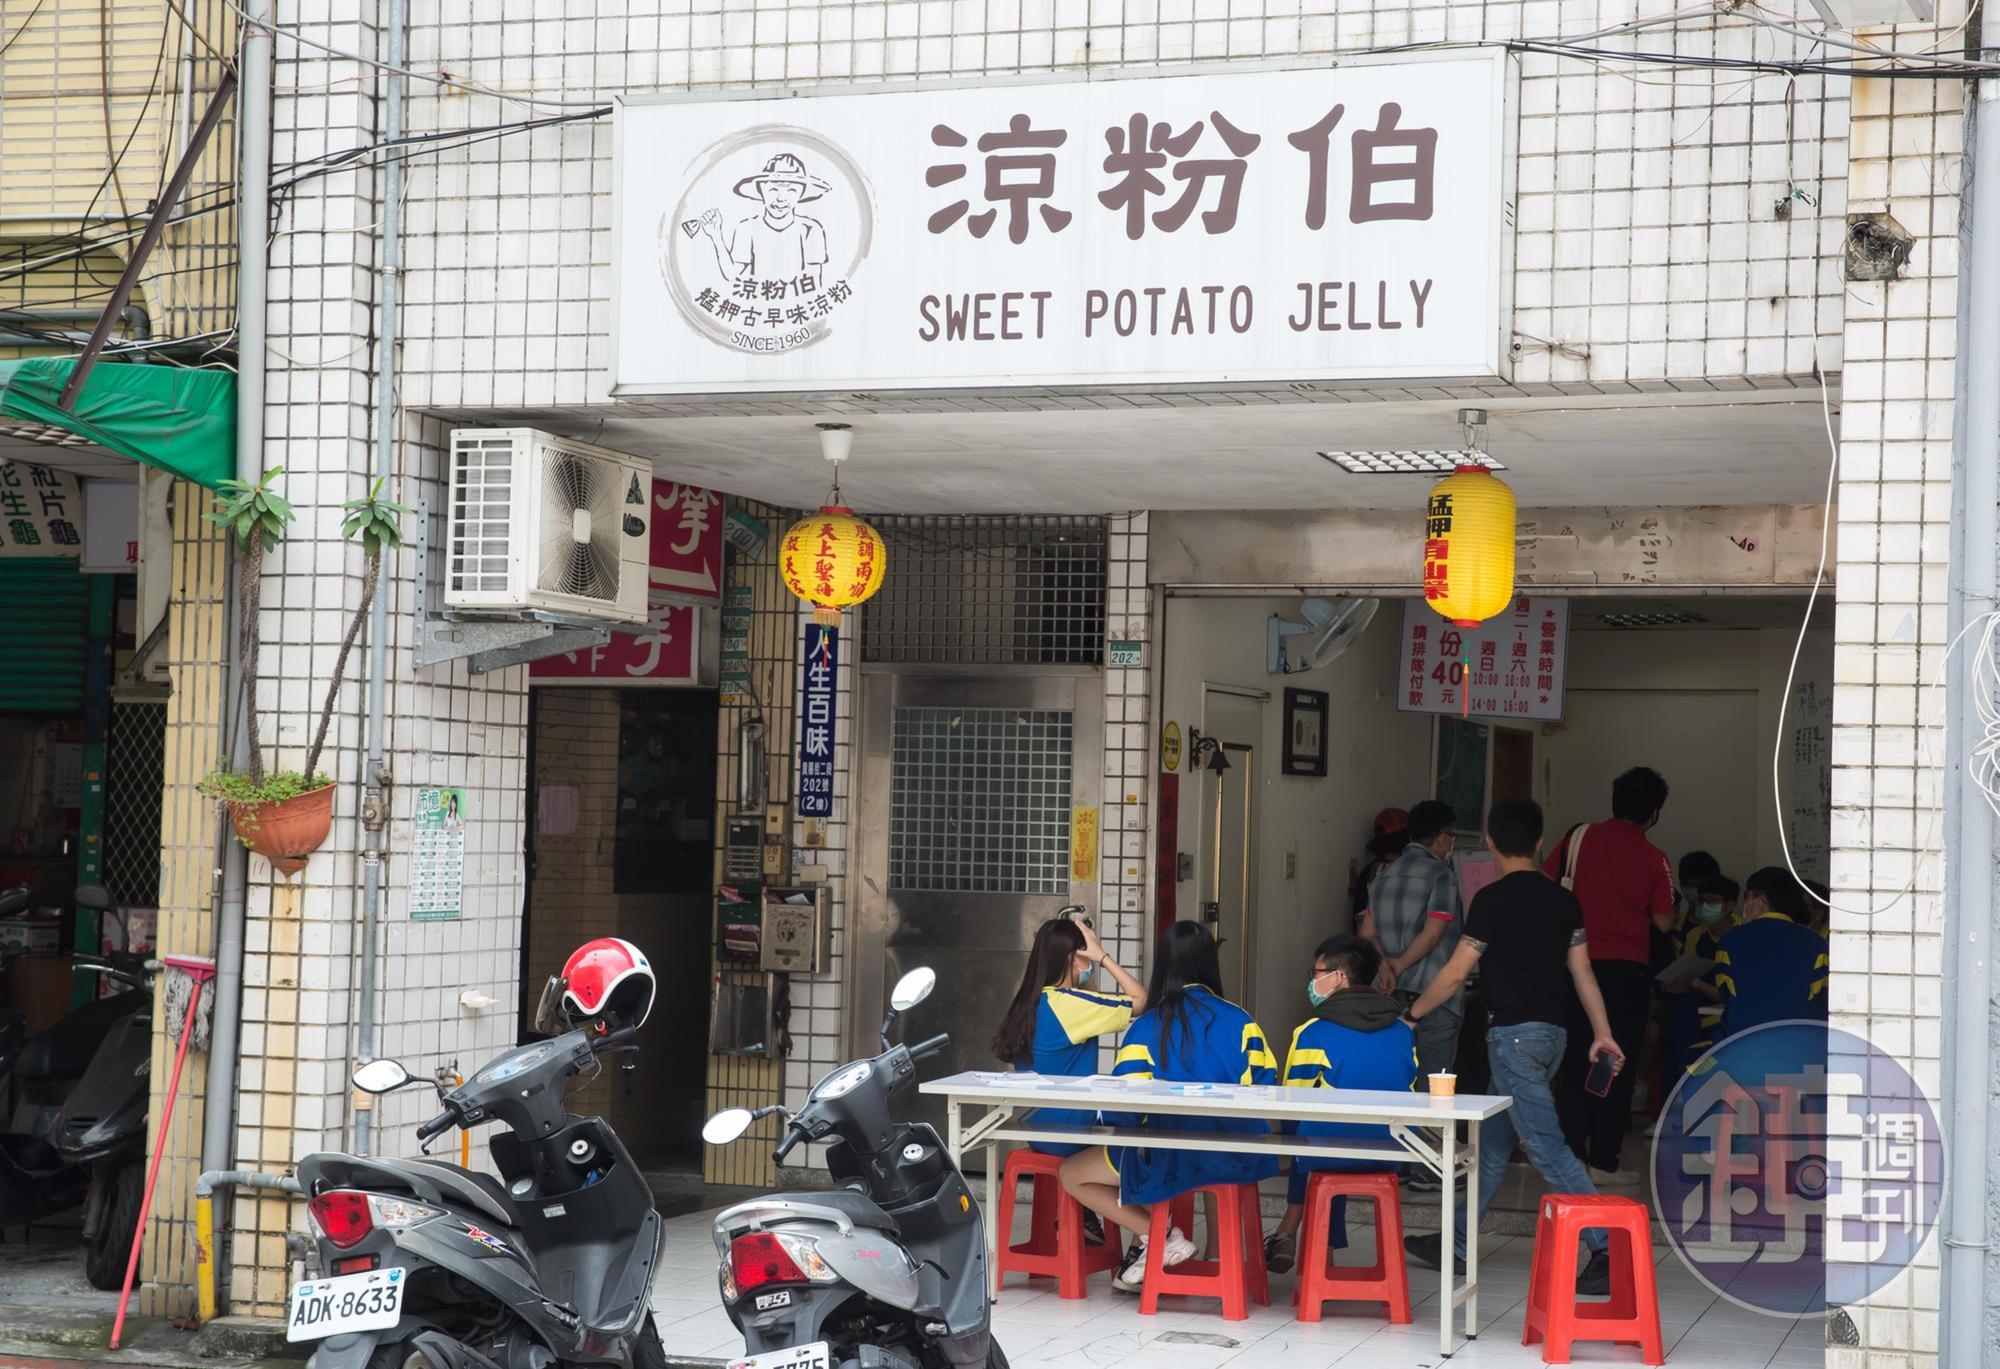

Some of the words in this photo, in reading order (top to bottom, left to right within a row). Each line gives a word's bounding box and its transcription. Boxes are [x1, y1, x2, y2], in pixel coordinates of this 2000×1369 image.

[925, 101, 1438, 245] 涼粉伯
[694, 279, 853, 329] 艋舺古早味涼粉
[731, 273, 816, 301] 涼粉伯
[918, 290, 1053, 342] SWEET
[1085, 285, 1254, 338] POTATO
[1288, 278, 1434, 332] JELLY
[730, 330, 775, 351] SINCE
[778, 327, 811, 350] 1960
[1111, 652, 1133, 664] 202
[1408, 625, 1428, 706] 請排隊付款
[1480, 641, 1496, 672] 週日
[1537, 622, 1557, 690] 營業時間
[806, 629, 832, 757] 人生百味
